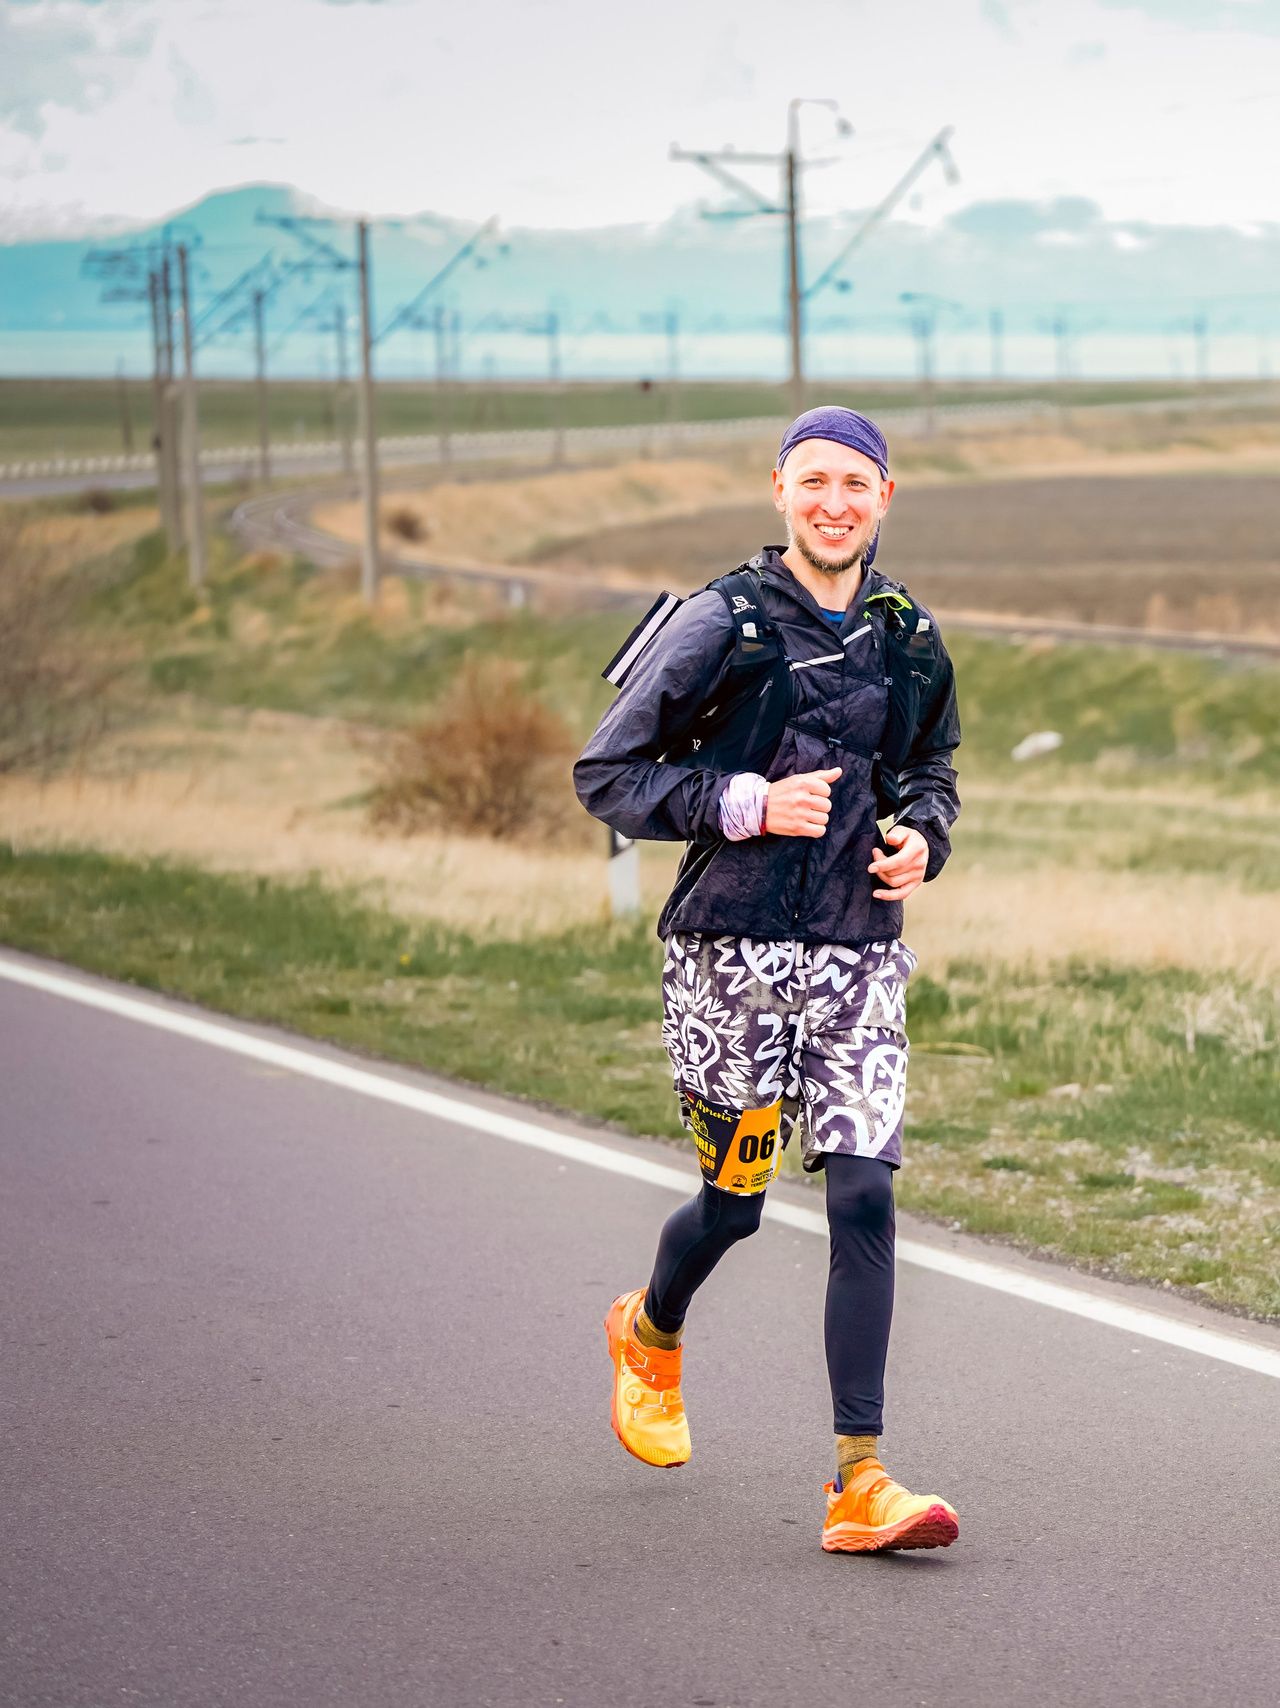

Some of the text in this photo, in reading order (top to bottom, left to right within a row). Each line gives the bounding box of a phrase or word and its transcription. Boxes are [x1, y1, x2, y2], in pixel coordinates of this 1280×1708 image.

[692, 738, 702, 751] 12
[696, 1099, 734, 1123] Armenia
[694, 1132, 717, 1159] ORLD
[739, 1129, 776, 1164] 06
